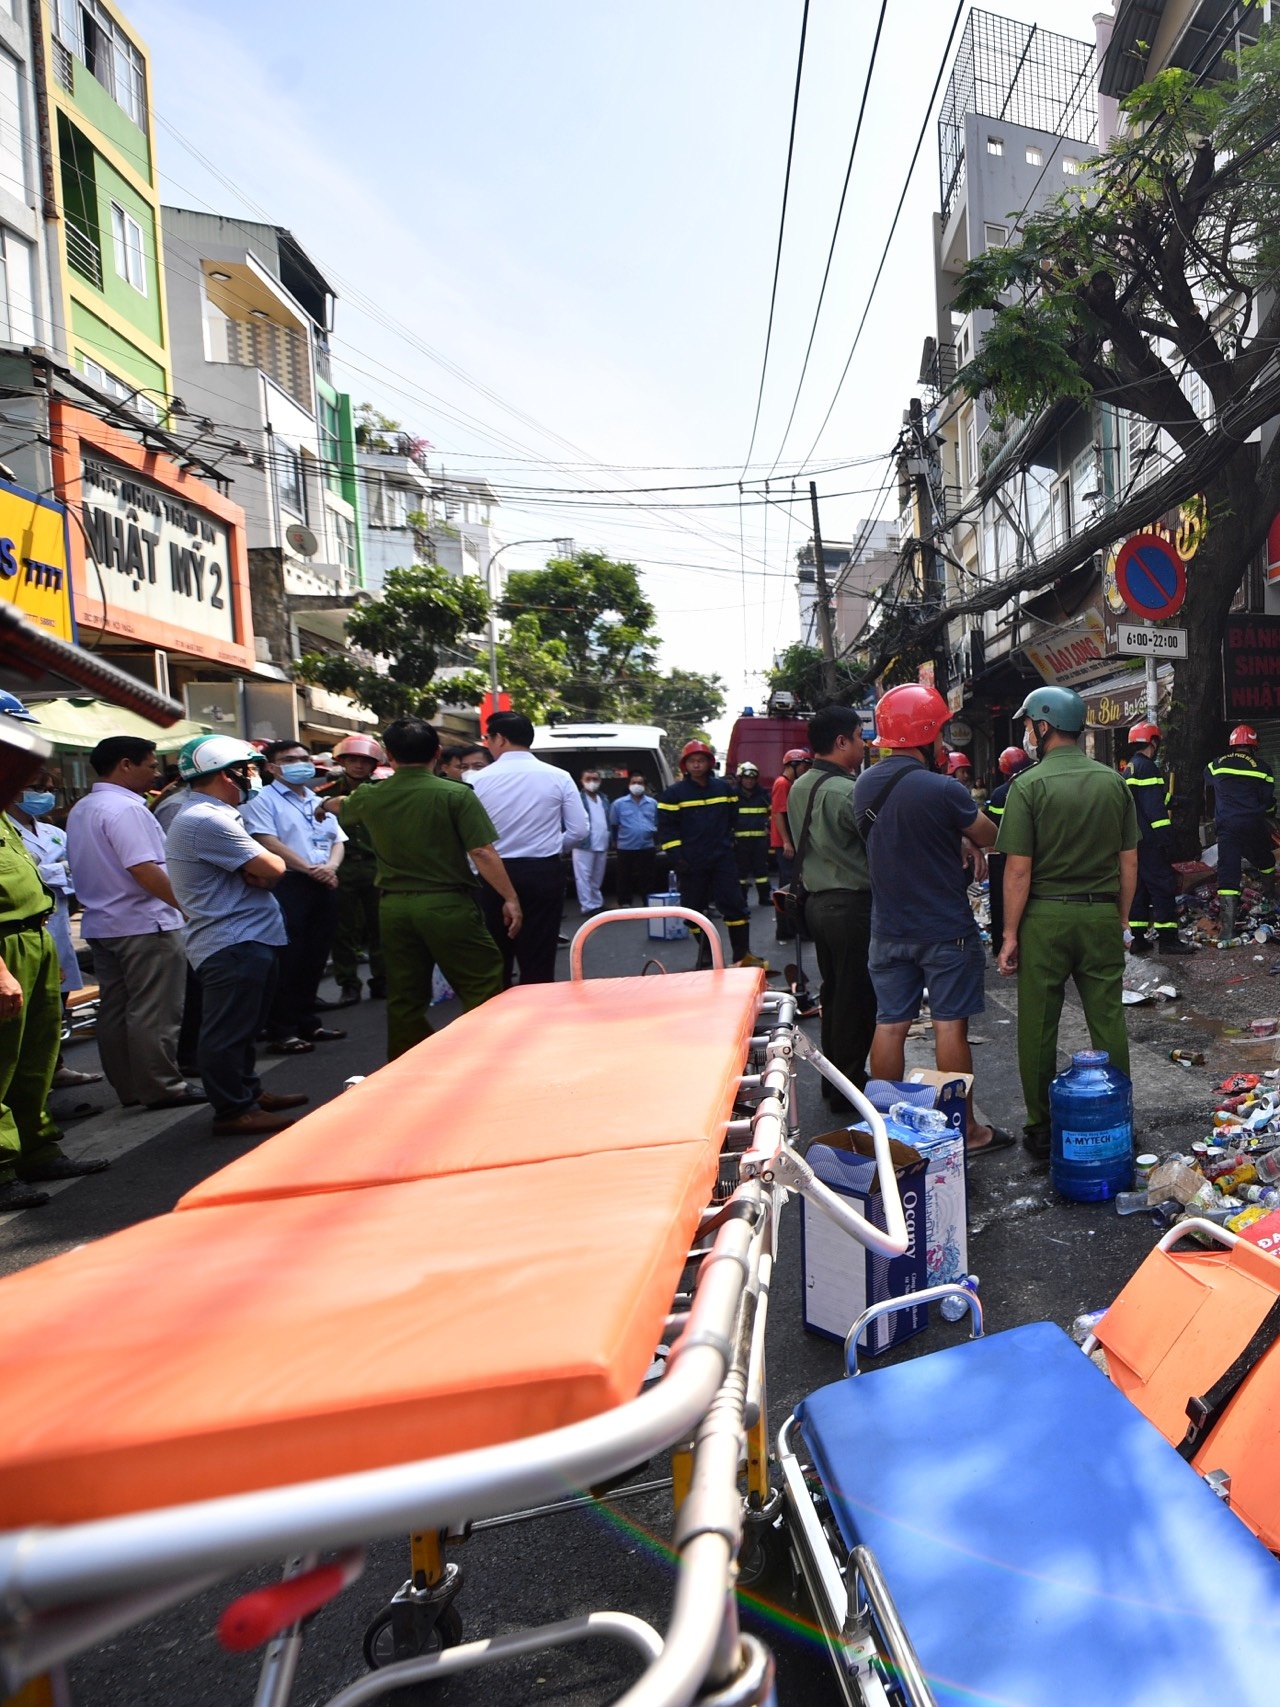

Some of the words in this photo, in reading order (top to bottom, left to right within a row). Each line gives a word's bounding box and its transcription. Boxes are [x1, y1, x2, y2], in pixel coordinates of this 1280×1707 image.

[84, 500, 159, 591] NHẬT
[170, 541, 206, 602] MỸ
[210, 562, 224, 609] 2
[24, 557, 63, 594] 7777
[1126, 632, 1179, 649] 6:00-22:00
[1098, 697, 1120, 724] Bin
[903, 1191, 918, 1260] Ocany
